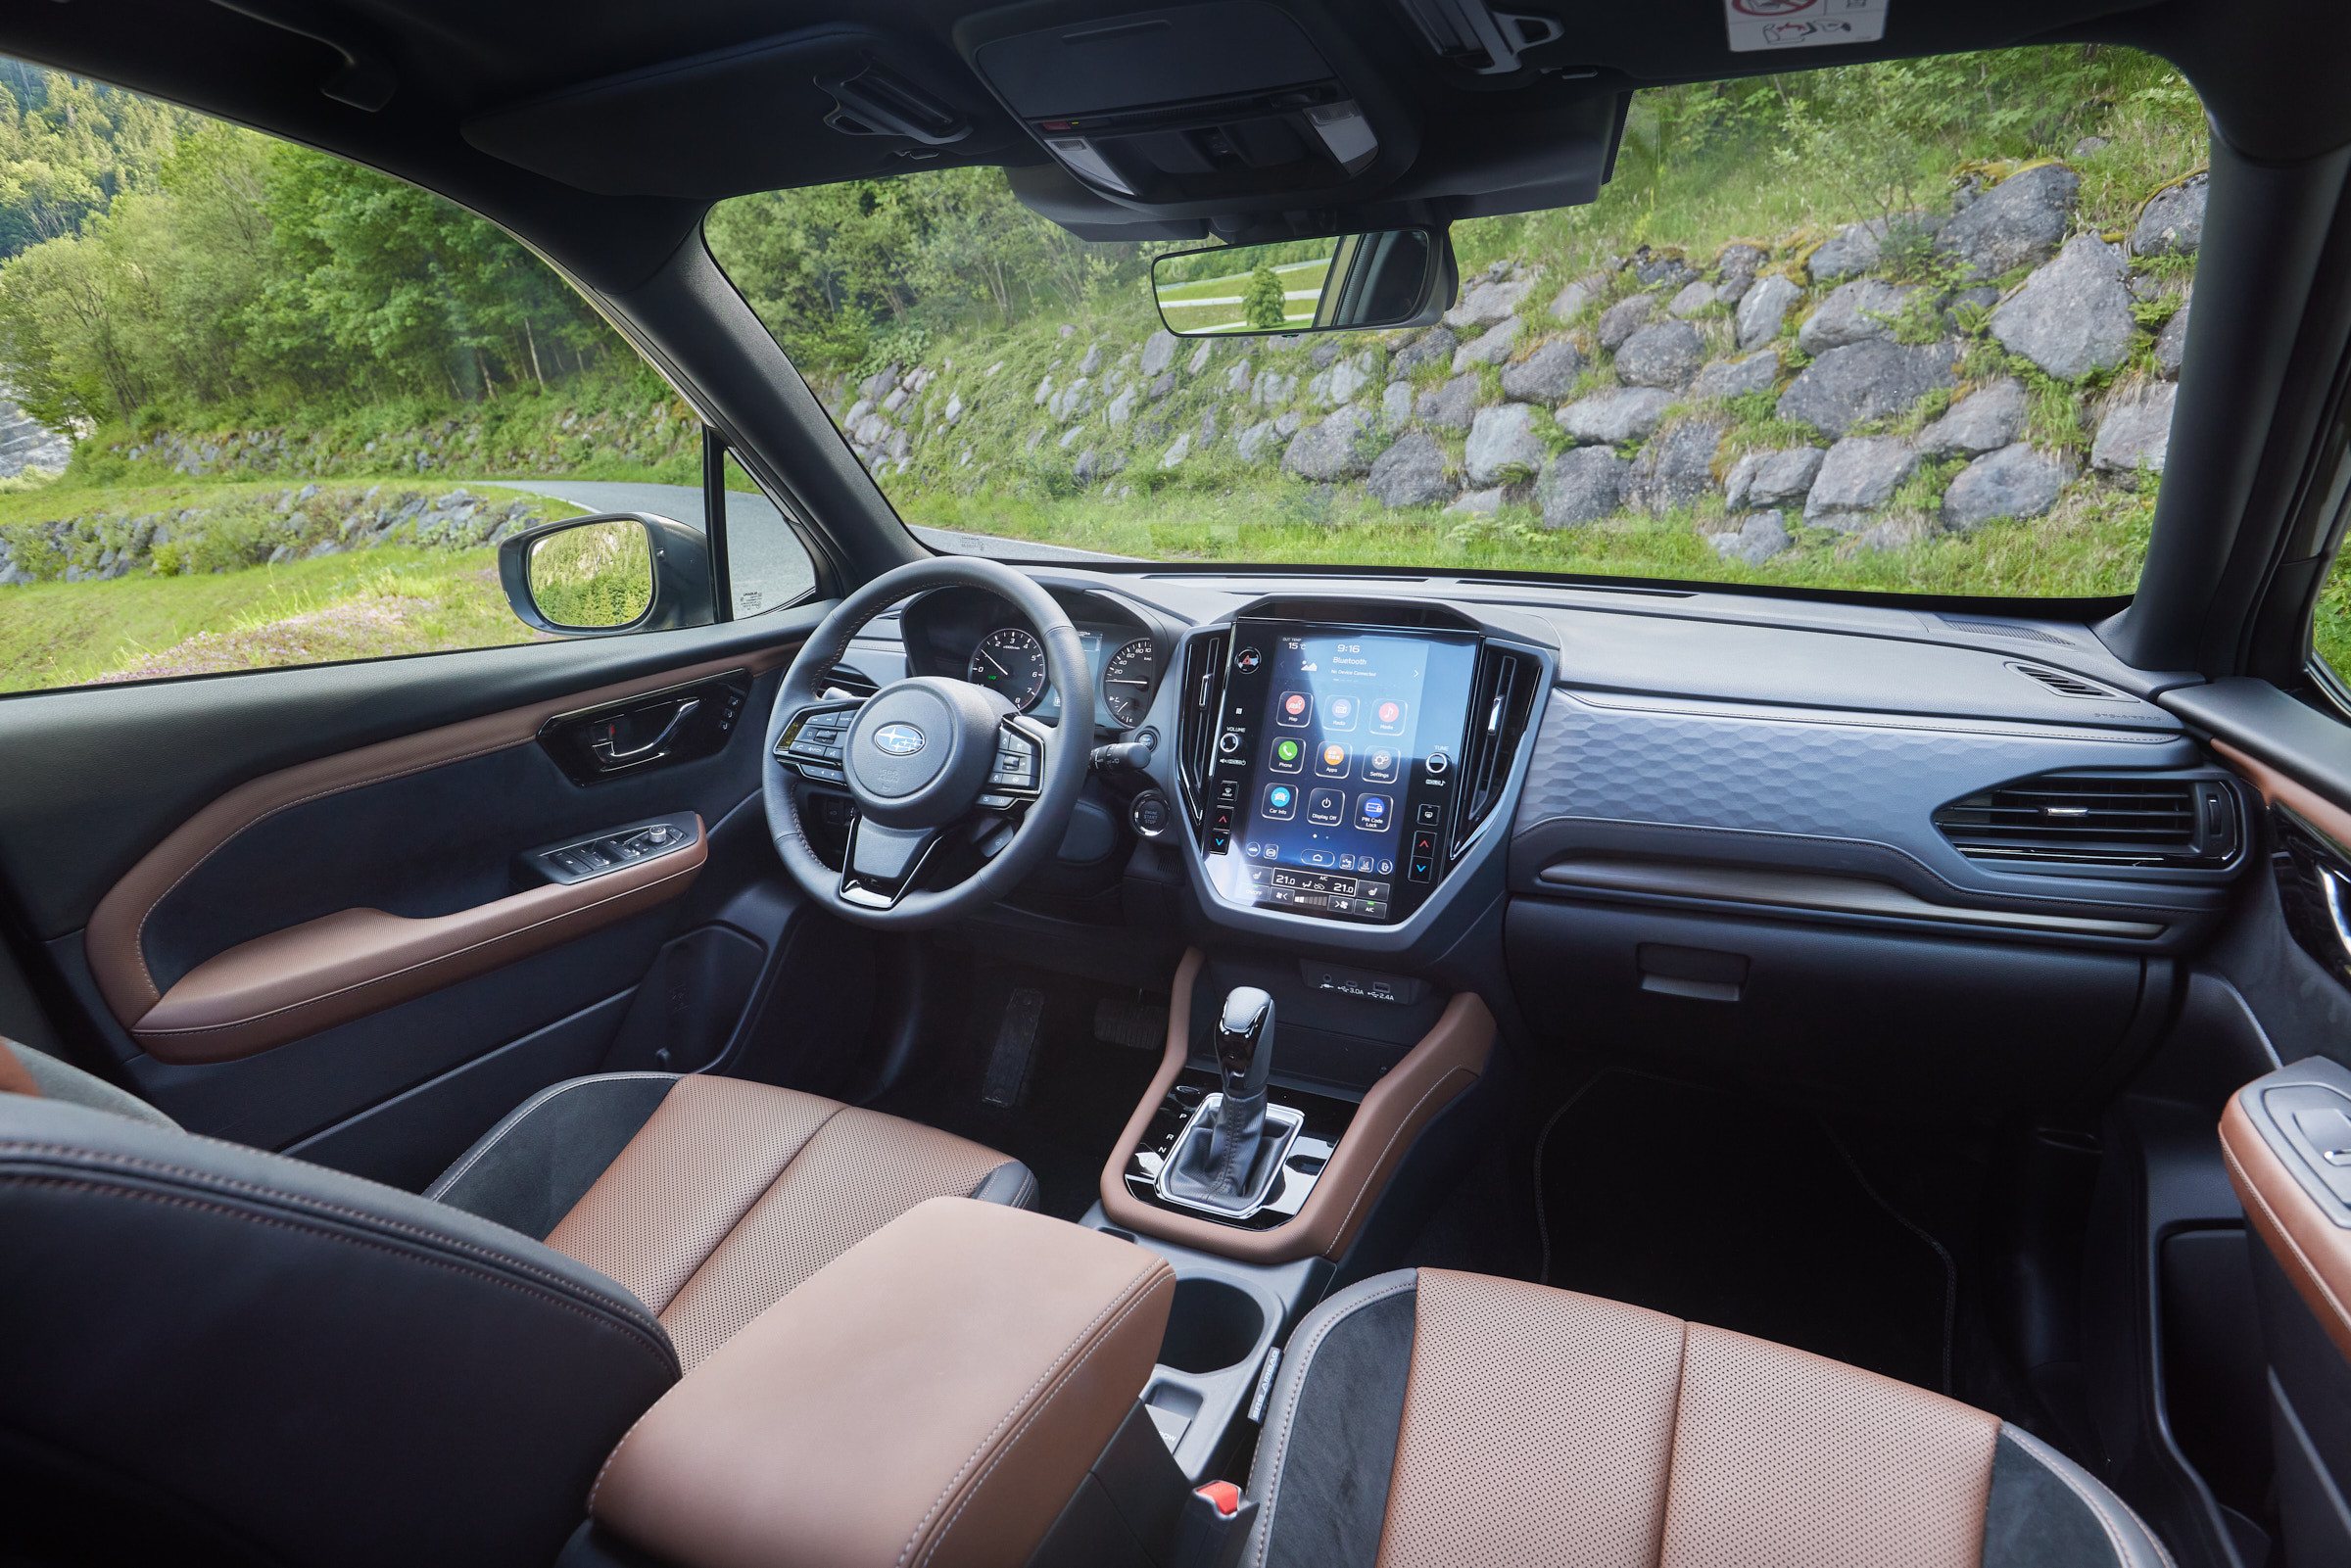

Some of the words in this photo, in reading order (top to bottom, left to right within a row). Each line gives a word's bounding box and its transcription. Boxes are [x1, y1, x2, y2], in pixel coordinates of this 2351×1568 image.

[1337, 644, 1361, 653] 9:16
[1332, 656, 1367, 665] Bluetooth
[1275, 875, 1296, 885] 21.0
[1333, 882, 1354, 893] 21.0
[1252, 1394, 1264, 1420] SRS
[1262, 1350, 1278, 1391] AIRBAG
